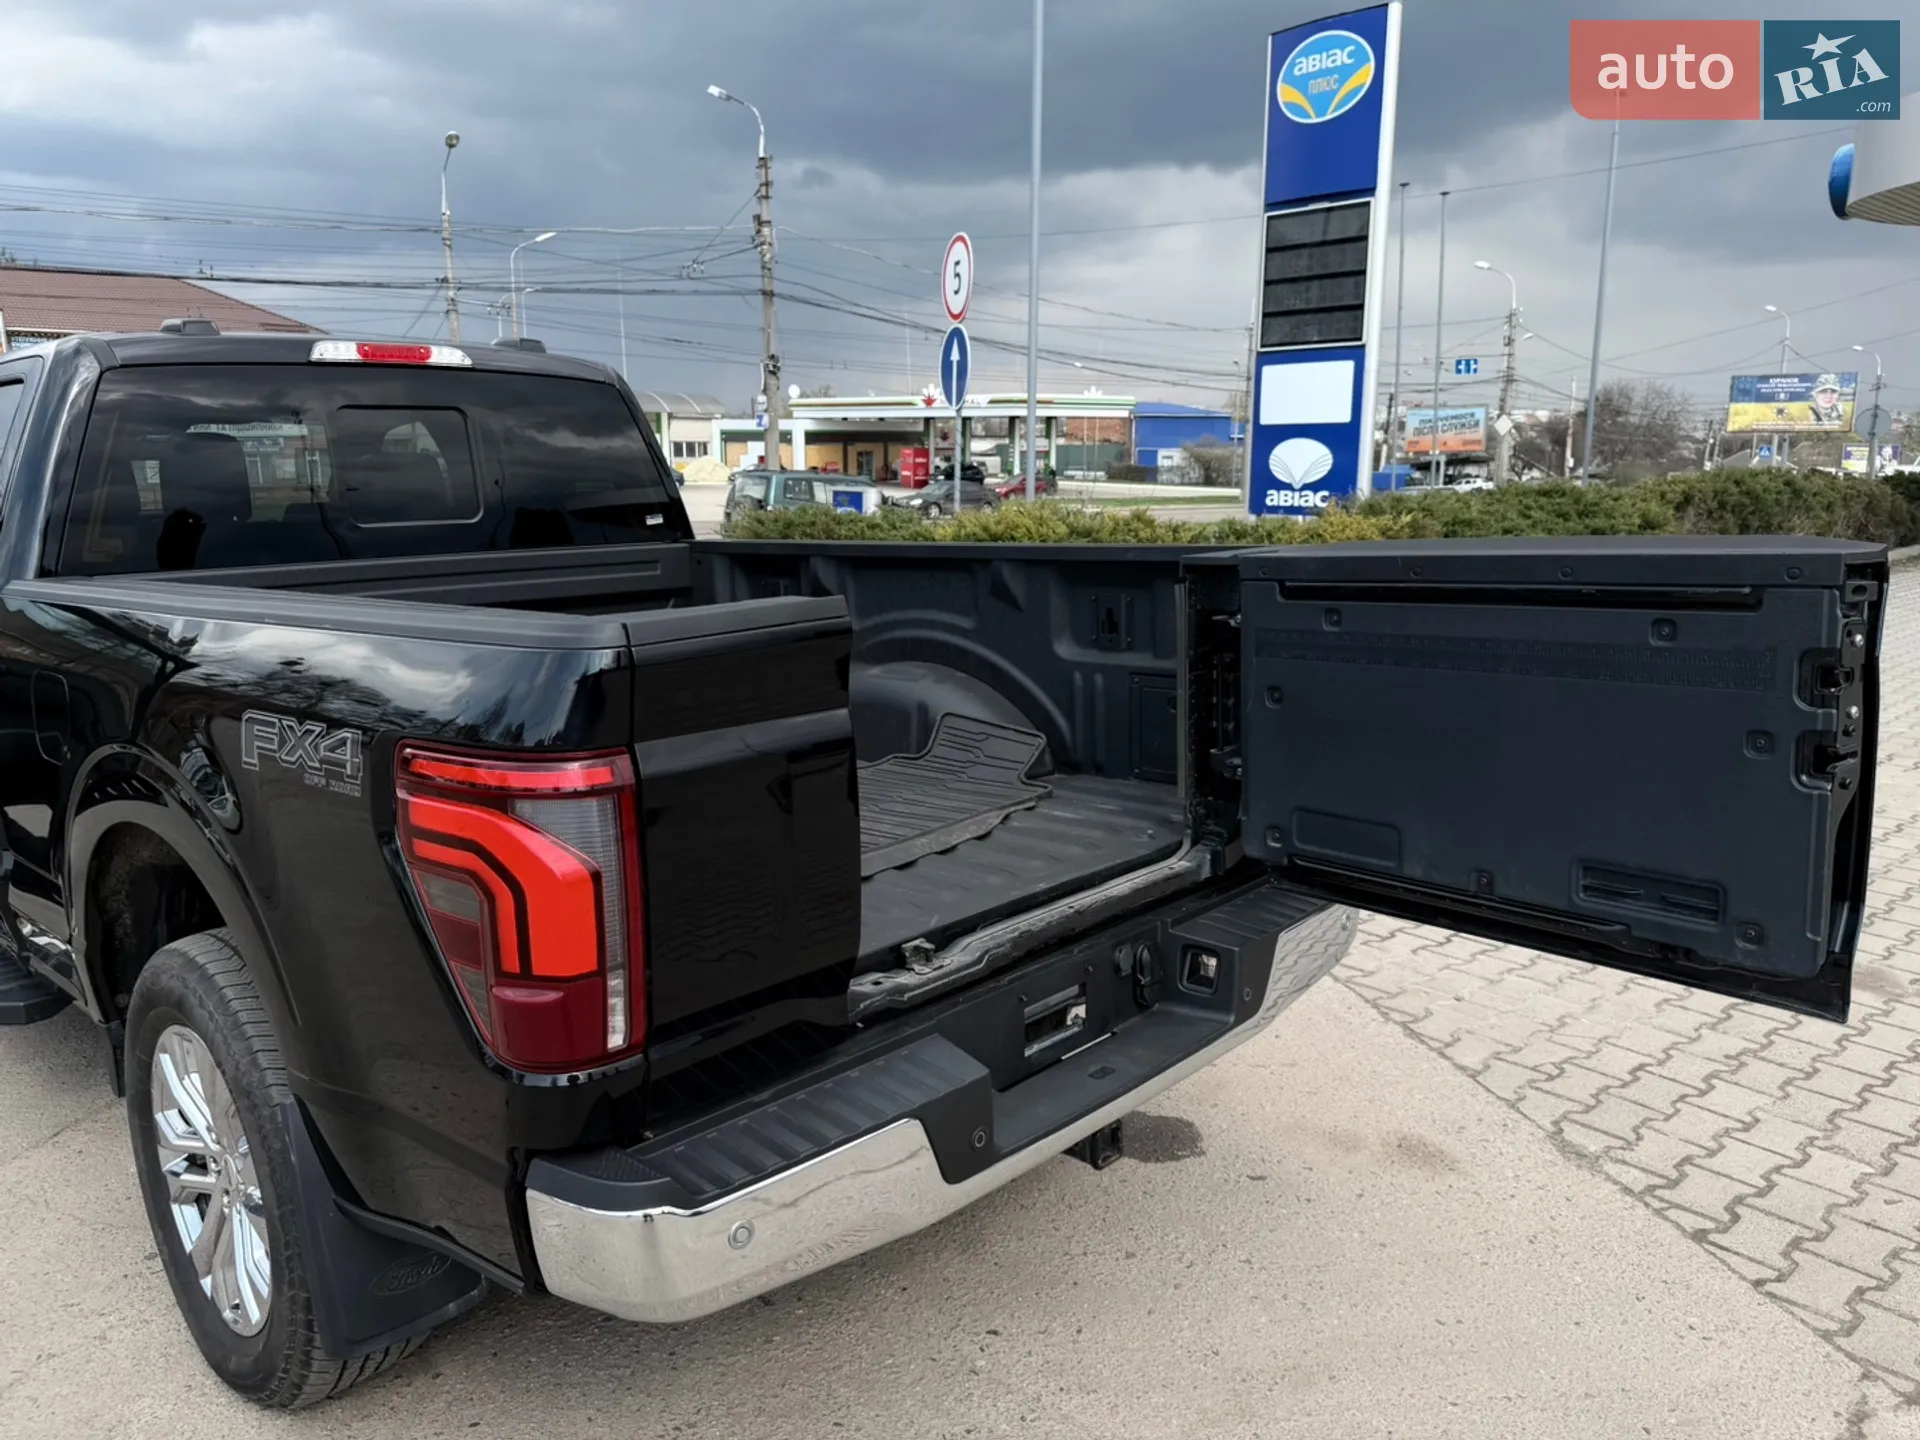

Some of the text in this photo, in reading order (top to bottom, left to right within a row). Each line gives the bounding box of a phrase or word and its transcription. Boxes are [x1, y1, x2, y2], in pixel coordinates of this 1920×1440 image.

[953, 259, 962, 296] 5
[242, 709, 363, 784] FX4
[386, 1254, 439, 1292] Ford
